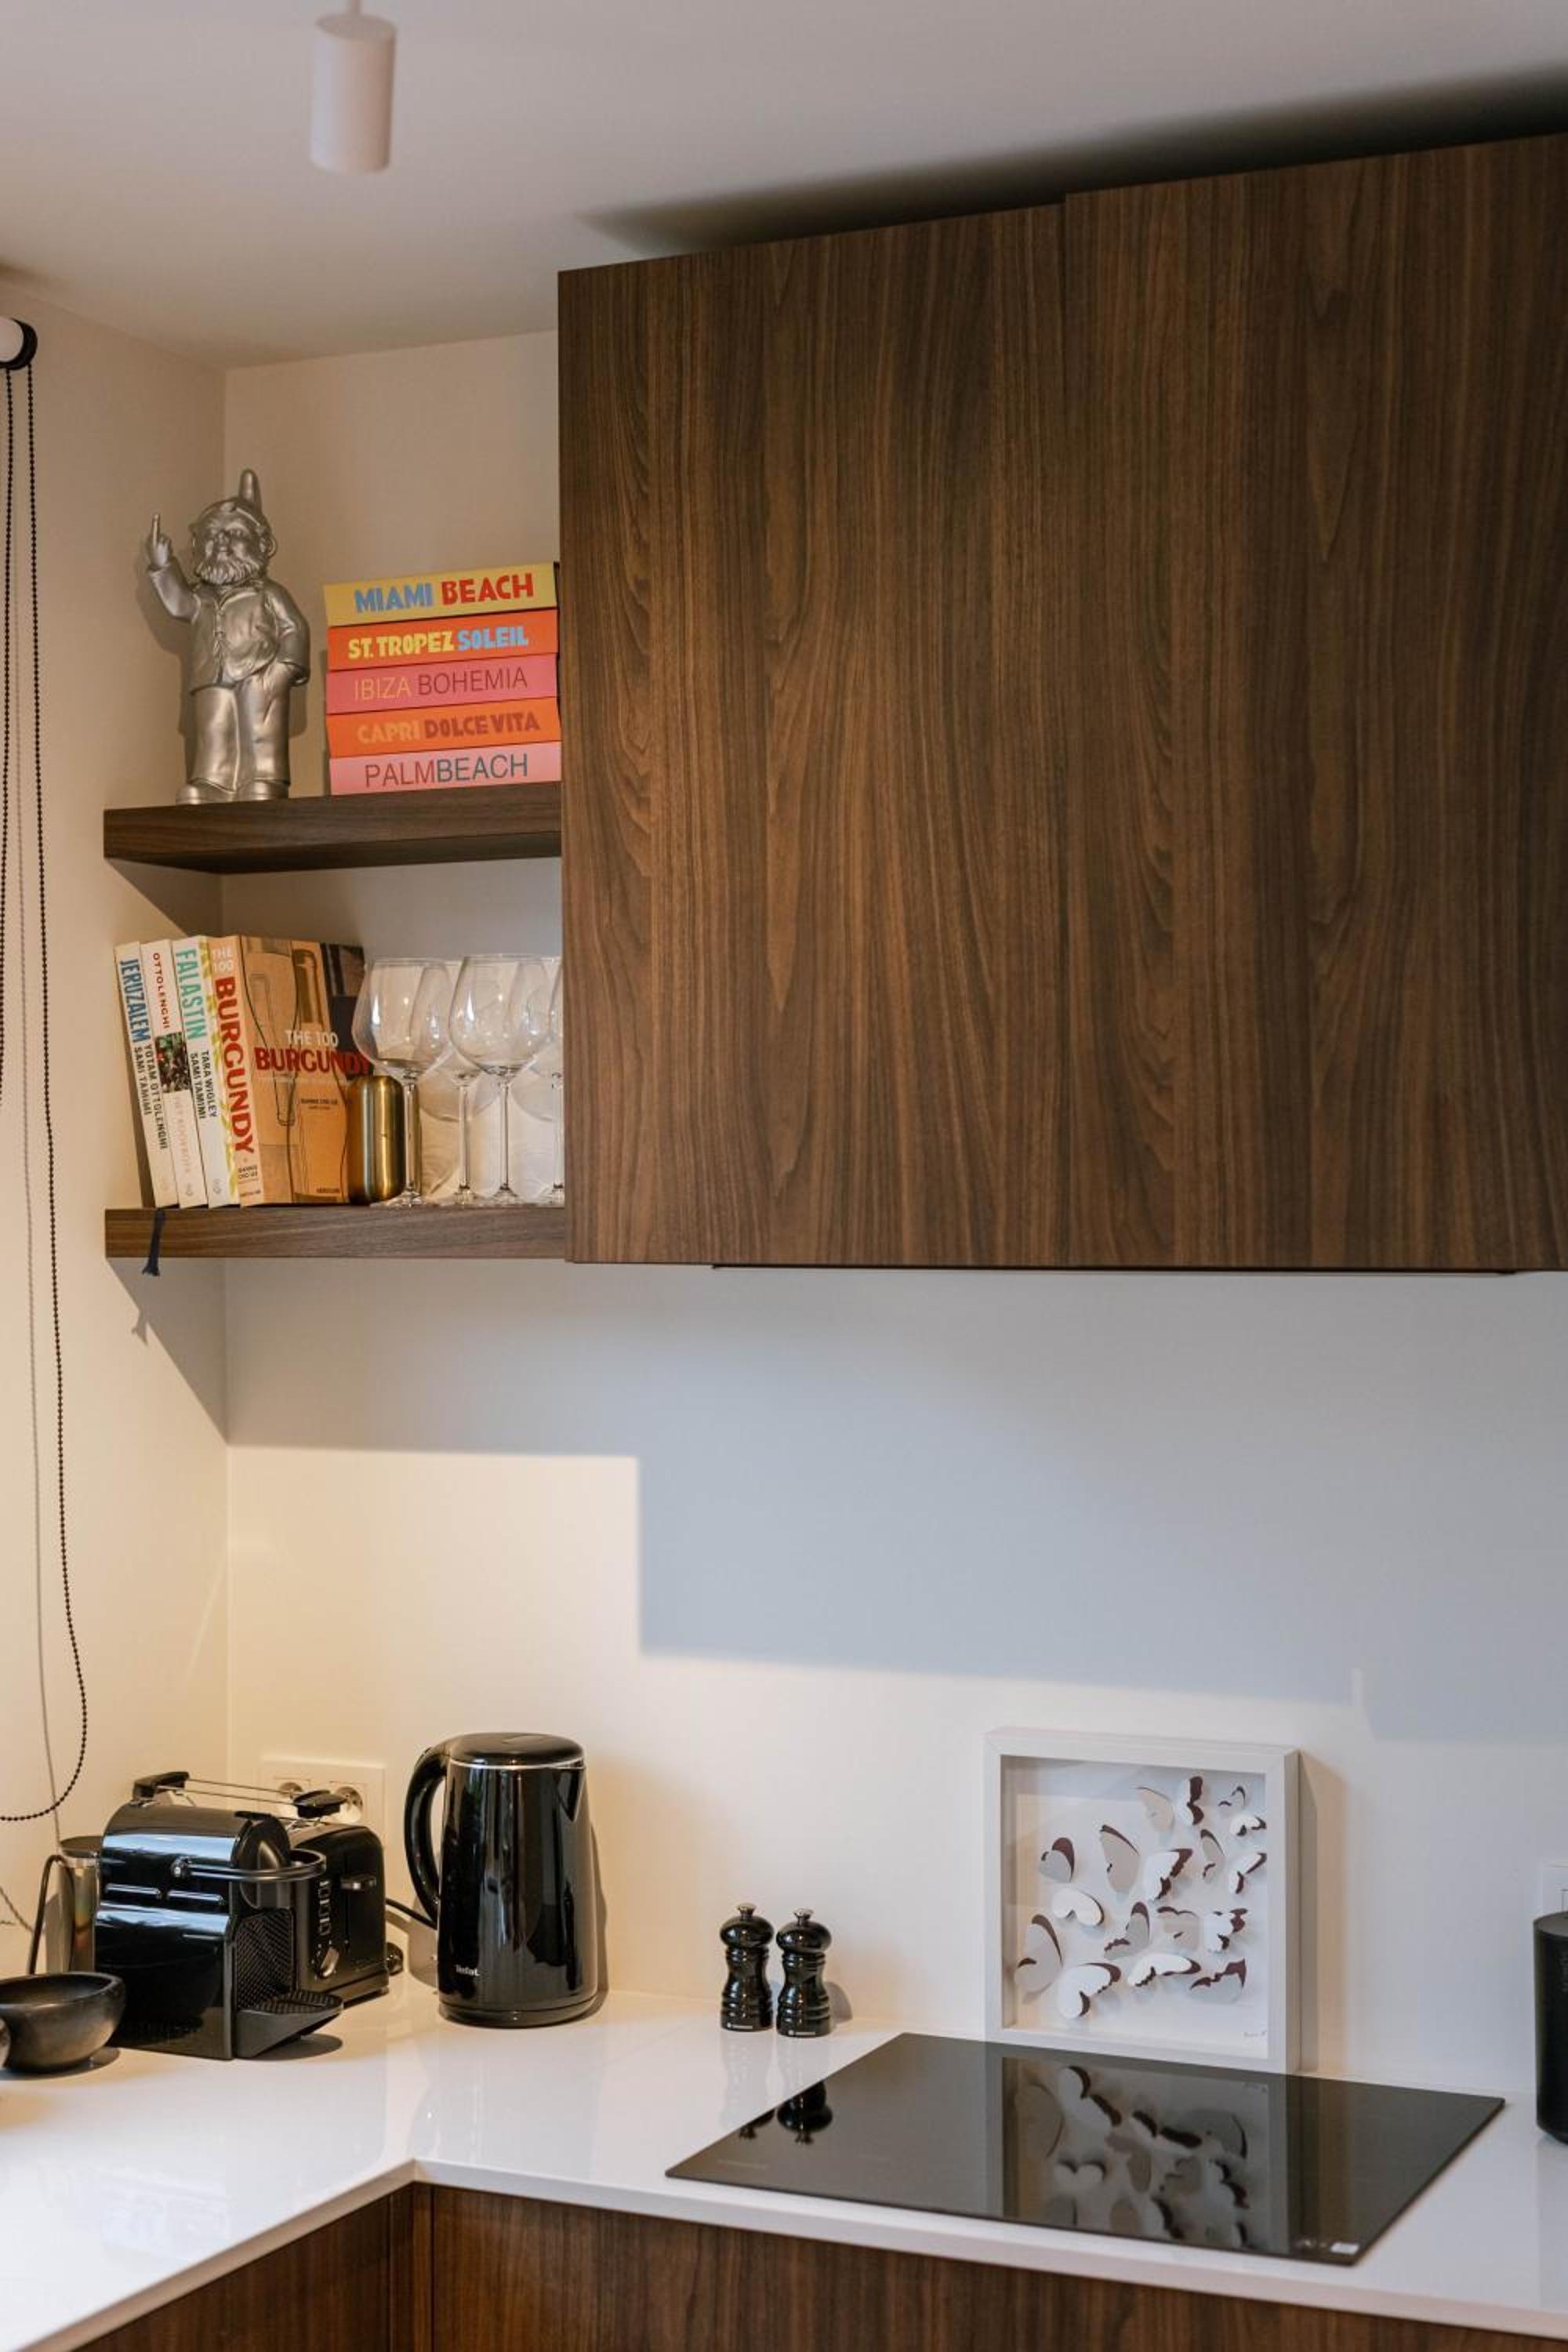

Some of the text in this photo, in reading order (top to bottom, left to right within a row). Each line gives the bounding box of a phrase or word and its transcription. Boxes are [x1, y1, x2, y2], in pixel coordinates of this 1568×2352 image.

[354, 573, 534, 613] MIAMI BEACH
[376, 631, 454, 657] TROPEZ
[457, 626, 529, 652] SOLEIL
[354, 666, 527, 700] IBIZA BOHEMIA
[358, 712, 540, 744] CAPRI DOLCE VITA
[212, 946, 233, 959] THE
[120, 959, 151, 1043] JERUZALEM
[153, 953, 170, 1029] OTTOLENGHI
[176, 949, 207, 1040] FALASTIN
[144, 1044, 157, 1080] YOTAM
[285, 1029, 339, 1047] THE 100
[134, 1047, 151, 1116] SAMI TAMIMI
[190, 1053, 206, 1119] SAMI TAMIMI
[201, 1051, 217, 1118] TARA WIGLEY
[216, 977, 254, 1154] BURGUNDY
